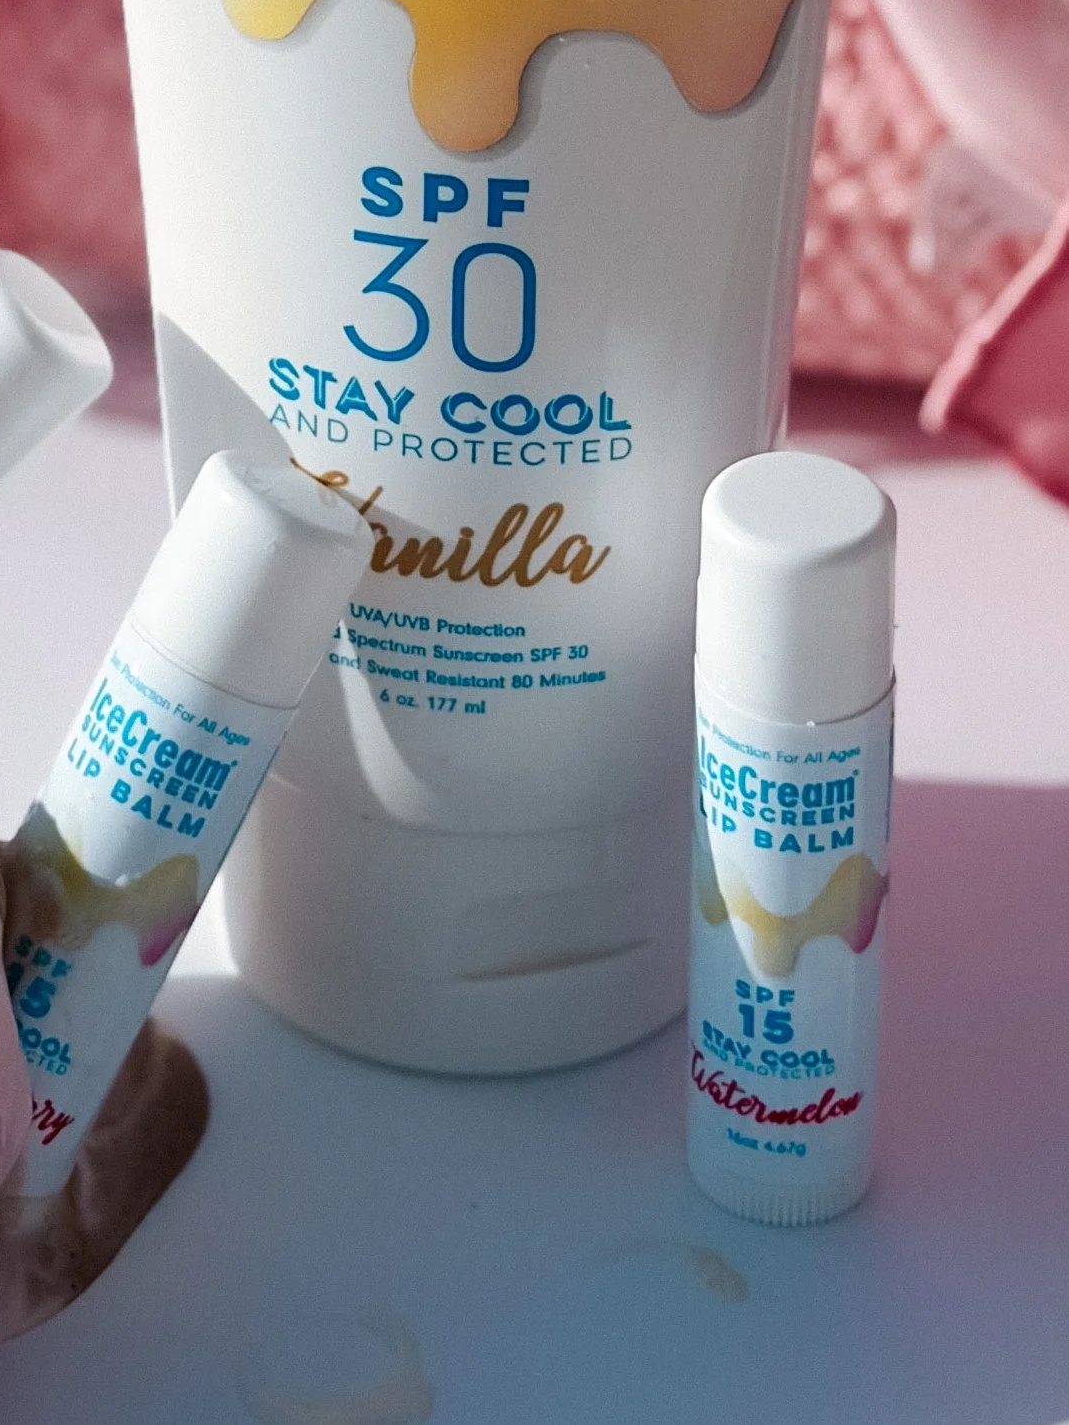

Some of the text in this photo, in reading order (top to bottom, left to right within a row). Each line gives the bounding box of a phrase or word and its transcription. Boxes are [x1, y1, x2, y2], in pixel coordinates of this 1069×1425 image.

[361, 166, 530, 228] SPF
[343, 229, 537, 373] 30
[269, 358, 632, 436] STAY COOL
[270, 404, 632, 465] AND PROTECTED
[349, 602, 526, 638] UVA/UVB Protection
[347, 629, 426, 657] Spectrum
[433, 644, 523, 663] Sunscreen
[530, 646, 562, 663] SPF
[568, 645, 589, 659] 30
[329, 652, 606, 689] and Sweat Resistant 80 Minutes
[173, 703, 195, 724] For
[198, 717, 218, 734] All
[380, 689, 390, 703] 6
[428, 696, 457, 713] 177
[464, 700, 486, 714] ml
[82, 714, 219, 810] SUNSCREEN
[776, 751, 799, 764] For
[804, 751, 823, 764] All
[67, 737, 206, 838] LIP BALM
[699, 772, 855, 826] SUNSCREEN
[753, 826, 854, 853] BALM
[735, 979, 795, 1007] SPF
[702, 1020, 835, 1069] STAY COOL
[738, 1003, 794, 1045] 15
[691, 1039, 864, 1125] Watermelon
